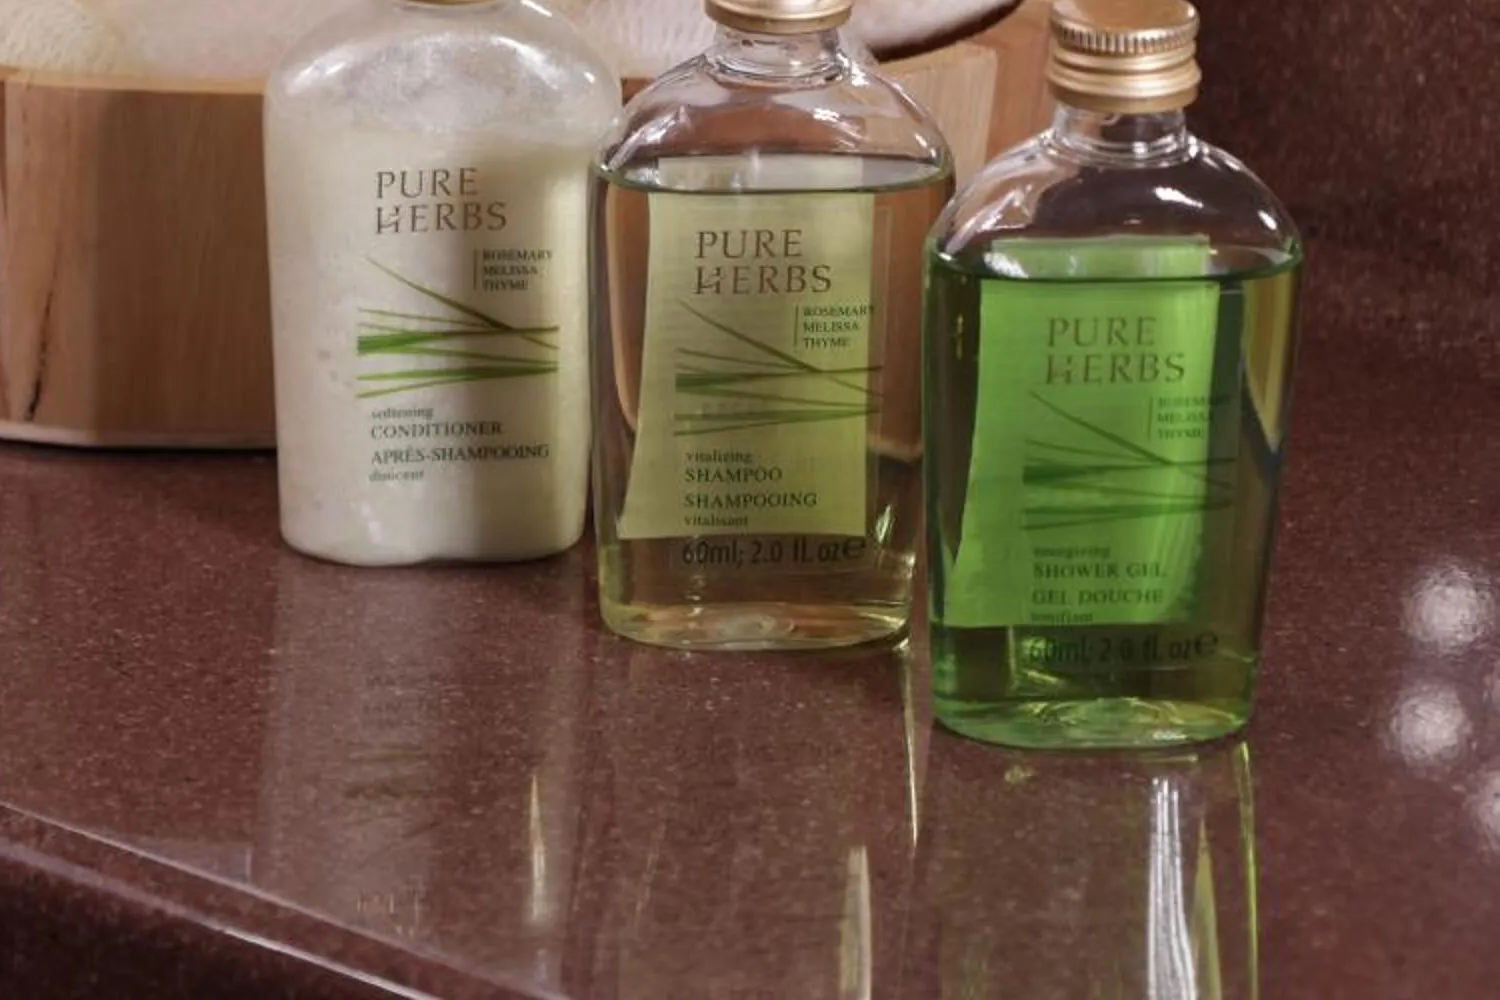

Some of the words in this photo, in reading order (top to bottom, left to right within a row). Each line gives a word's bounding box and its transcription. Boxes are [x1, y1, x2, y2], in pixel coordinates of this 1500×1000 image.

[376, 167, 478, 199] PURE
[376, 201, 507, 234] HERBS
[695, 229, 803, 259] PURE
[693, 264, 832, 296] HERBS
[803, 337, 851, 349] THYME
[1048, 316, 1157, 348] PURE
[1045, 352, 1187, 385] HERBS
[370, 421, 504, 439] CONDITIONER
[684, 466, 783, 483] SHAMPOO
[683, 491, 818, 509] SHAMPOOING
[1033, 562, 1119, 580] SHOWER
[1125, 562, 1168, 579] GEL
[1031, 588, 1070, 606] GEL
[1078, 587, 1165, 606] DOUCHE
